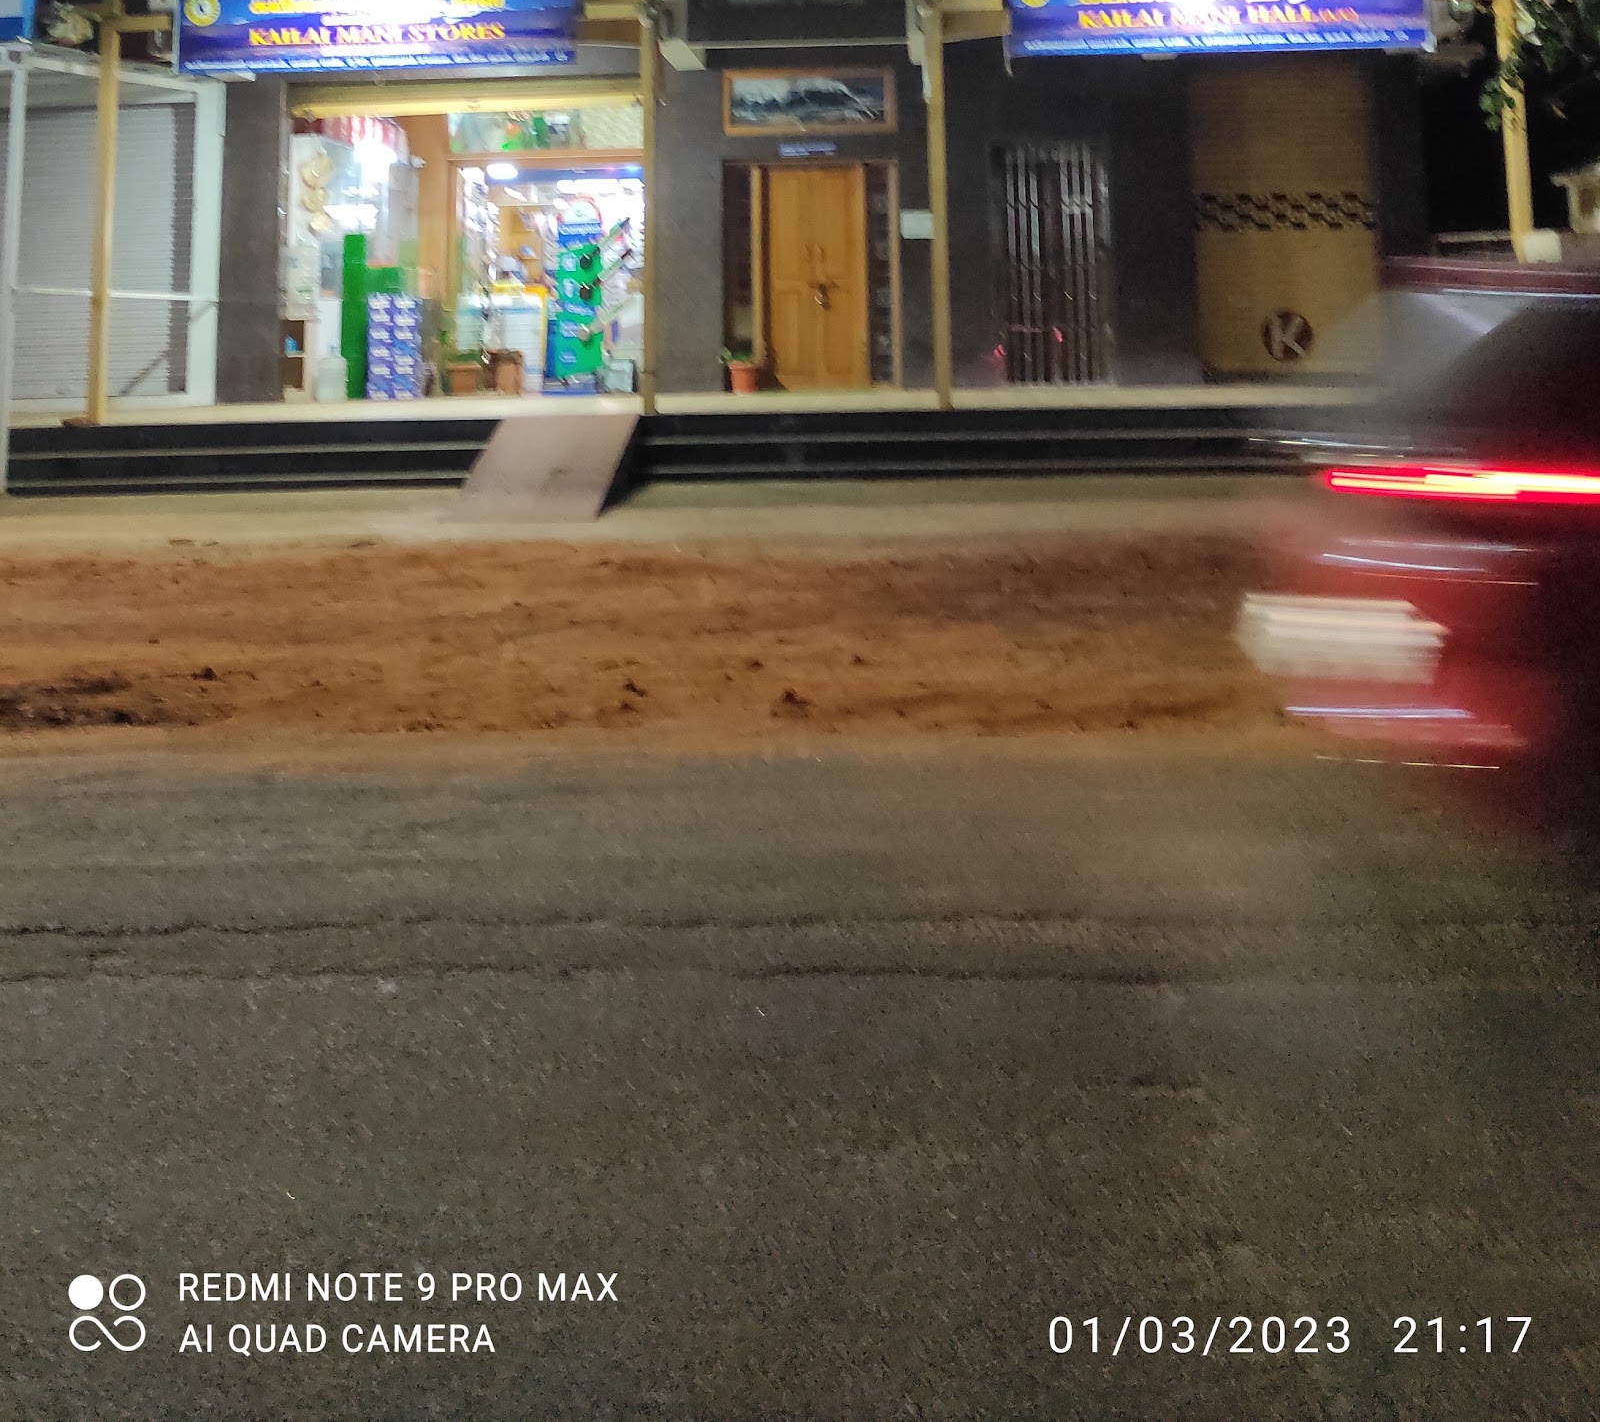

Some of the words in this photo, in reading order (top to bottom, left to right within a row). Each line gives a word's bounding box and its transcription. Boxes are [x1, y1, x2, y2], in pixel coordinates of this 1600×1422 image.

[1077, 7, 1165, 29] KAILAI
[1245, 2, 1318, 25] HALL
[247, 27, 333, 47] KAILAI
[406, 20, 506, 43] STORES
[1267, 312, 1308, 361] K
